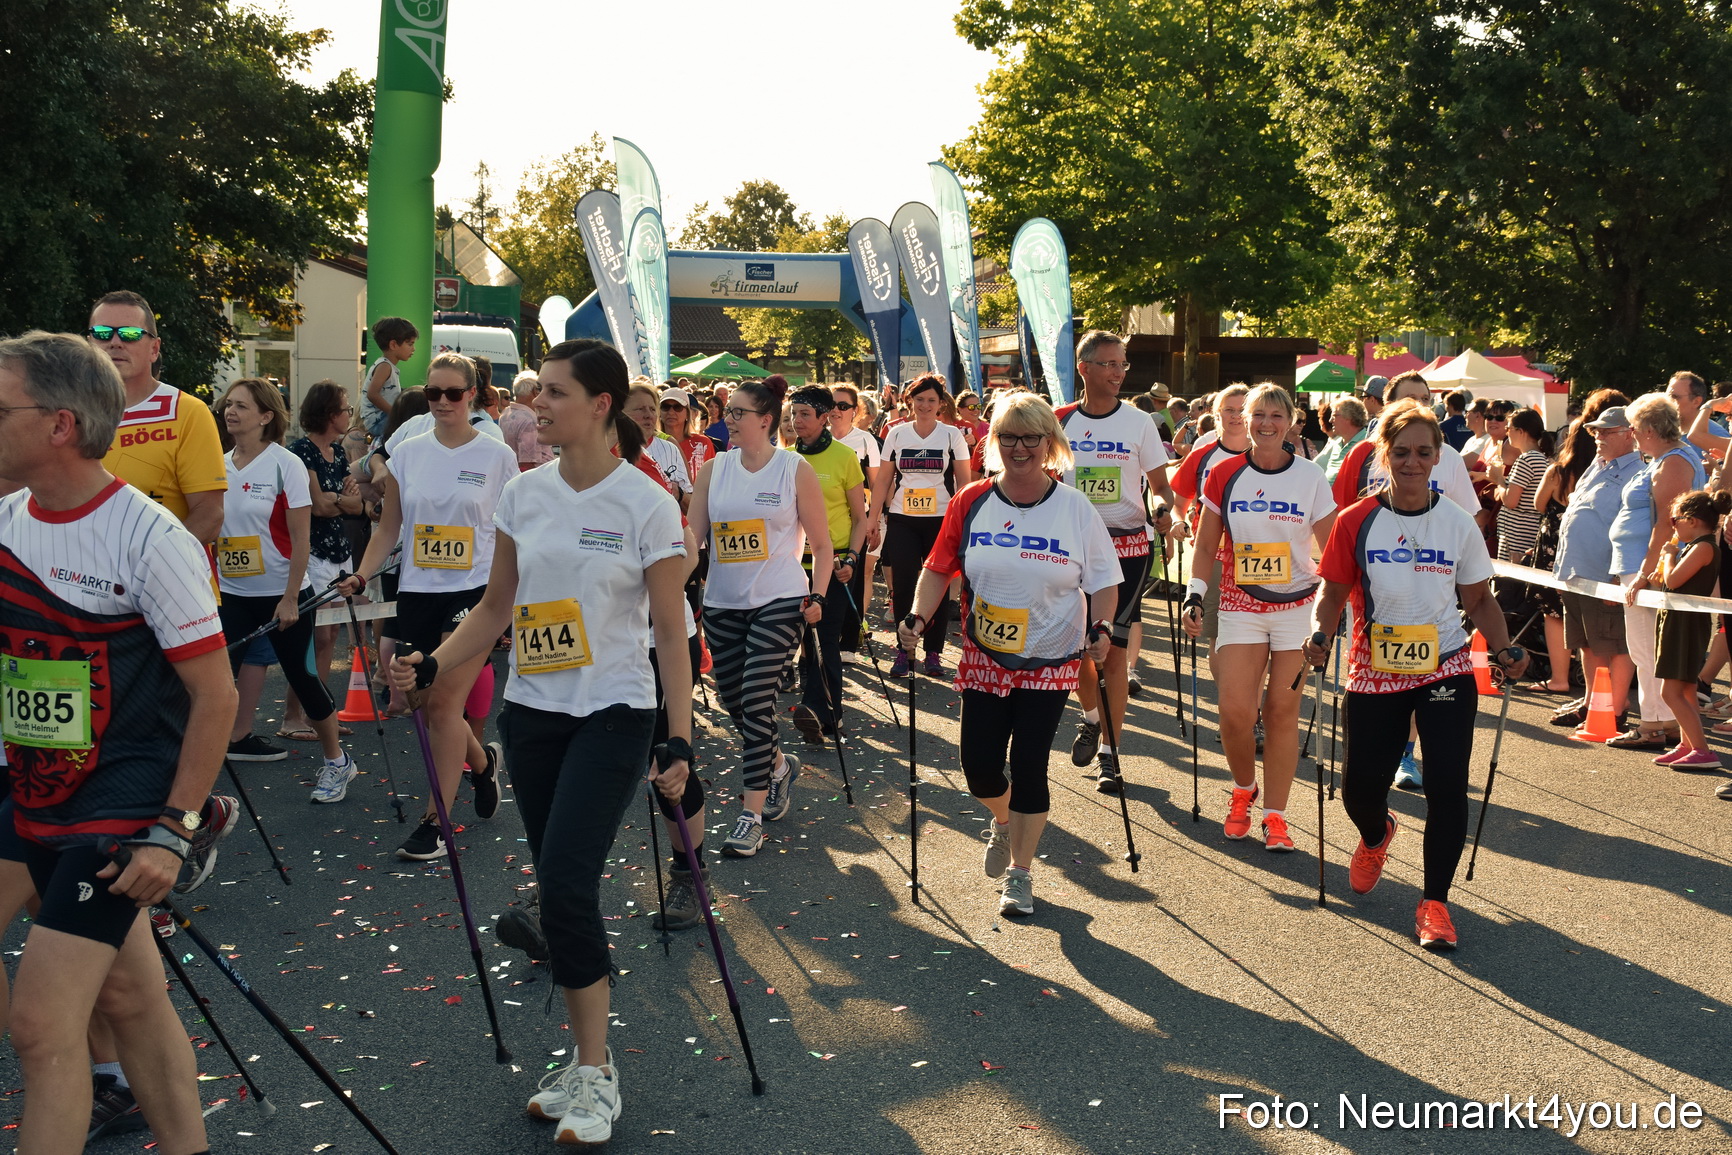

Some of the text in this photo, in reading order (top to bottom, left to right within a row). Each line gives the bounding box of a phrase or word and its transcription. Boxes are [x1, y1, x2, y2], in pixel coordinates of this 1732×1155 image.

[735, 280, 800, 294] firmenlauf
[120, 427, 178, 448] BÖGL
[1096, 452, 1130, 461] energie
[1080, 479, 1116, 493] 1743
[906, 497, 932, 507] 1617
[1268, 512, 1304, 525] energie
[421, 539, 465, 557] 1410
[579, 538, 623, 551] NeuerMarkt
[720, 533, 760, 552] 1416
[224, 550, 250, 566] 256
[1020, 551, 1069, 566] energie
[1241, 557, 1283, 573] 1741
[50, 566, 112, 592] NEUMARKT
[978, 614, 1019, 641] 1742
[520, 624, 575, 654] 1414
[527, 651, 567, 662] Mendl Nadine
[1379, 642, 1430, 660] 1740
[7, 687, 75, 724] 1885
[14, 721, 60, 734] Senft Helmut
